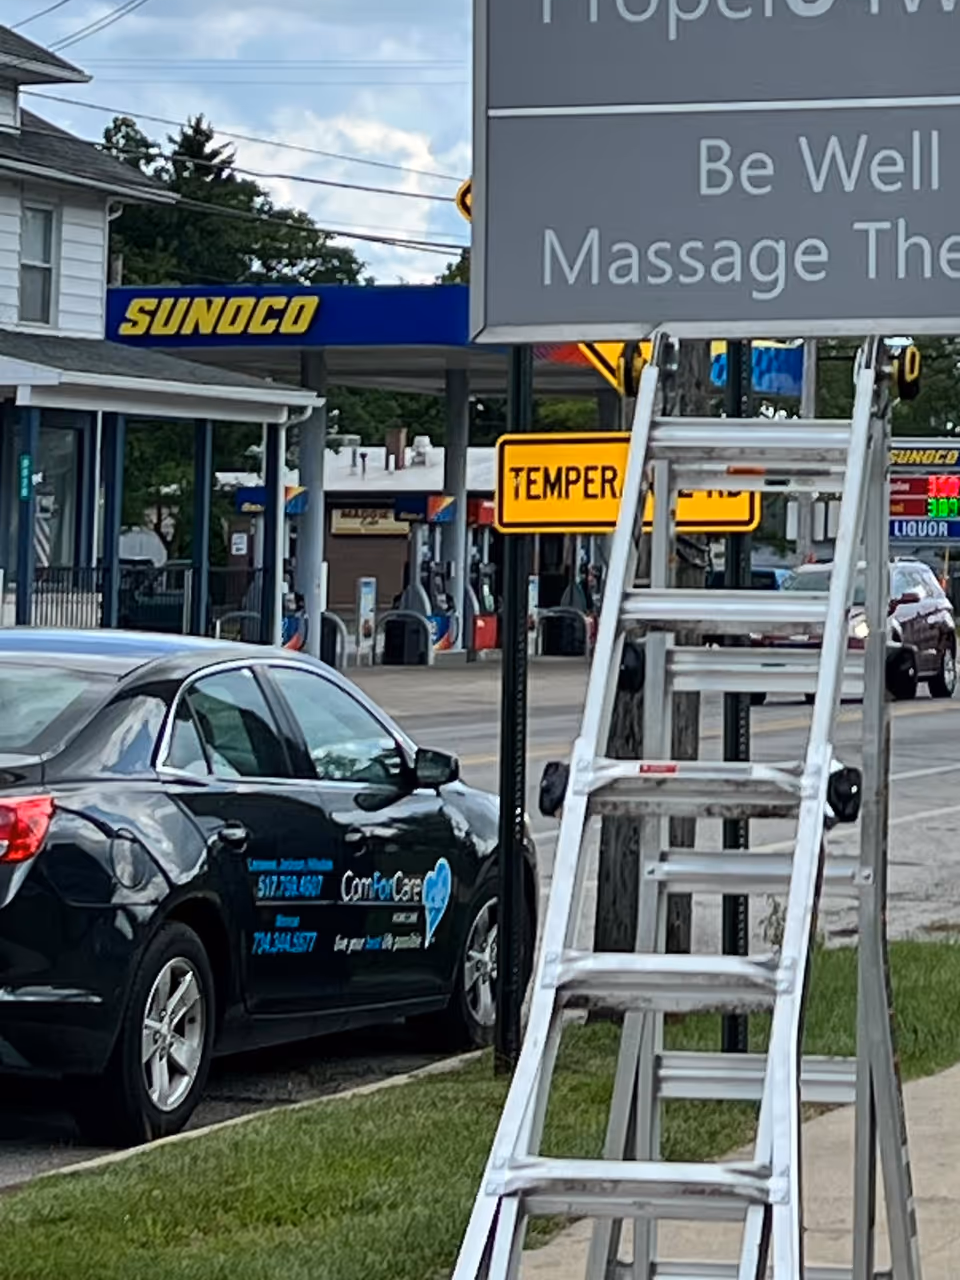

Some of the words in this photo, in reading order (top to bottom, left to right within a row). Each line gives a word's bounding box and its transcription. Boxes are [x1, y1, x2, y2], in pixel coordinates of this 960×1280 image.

[699, 136, 775, 196] Be
[798, 129, 941, 194] Well
[541, 226, 829, 300] Massage
[117, 294, 320, 336] SUNOCO
[889, 449, 960, 465] SUNOCO
[893, 521, 949, 537] LIQUOR
[341, 869, 422, 902] ComForCare
